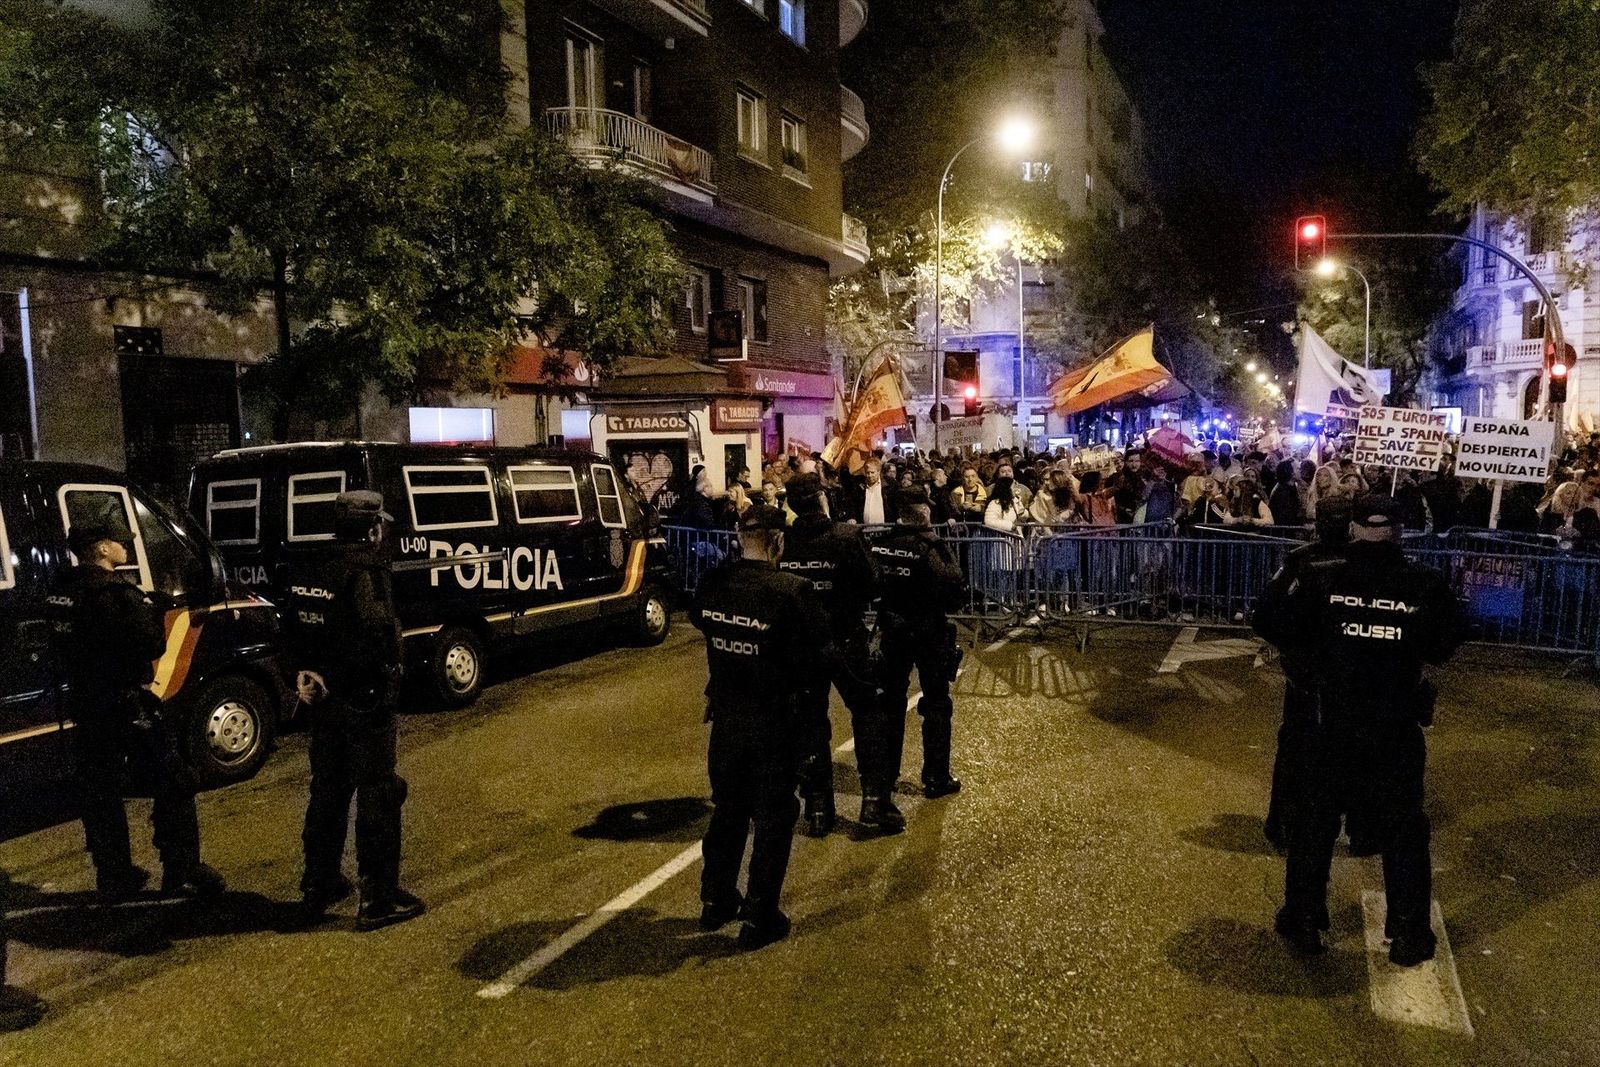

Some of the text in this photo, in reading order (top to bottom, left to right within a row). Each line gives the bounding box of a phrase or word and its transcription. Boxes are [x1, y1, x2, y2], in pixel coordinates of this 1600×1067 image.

[764, 378, 797, 393] Santander
[729, 407, 760, 418] TABACOS
[1361, 407, 1386, 420] SOS
[1392, 411, 1446, 426] EUROPE
[625, 417, 687, 430] TABACOS
[1473, 423, 1530, 436] ESPAÑA
[1358, 425, 1443, 441] HELP SPAIN
[1379, 440, 1415, 452] SAVE
[1355, 451, 1437, 469] DEMOCRACY
[1459, 460, 1546, 477] MOVILÍZATE
[400, 536, 427, 554] U-00
[871, 546, 915, 558] POLICIA
[429, 540, 565, 591] POLICIA
[780, 561, 830, 570] POLICIA
[292, 586, 330, 600] POLICIA
[1330, 594, 1408, 613] POLICIA
[702, 609, 760, 630] POLICIA
